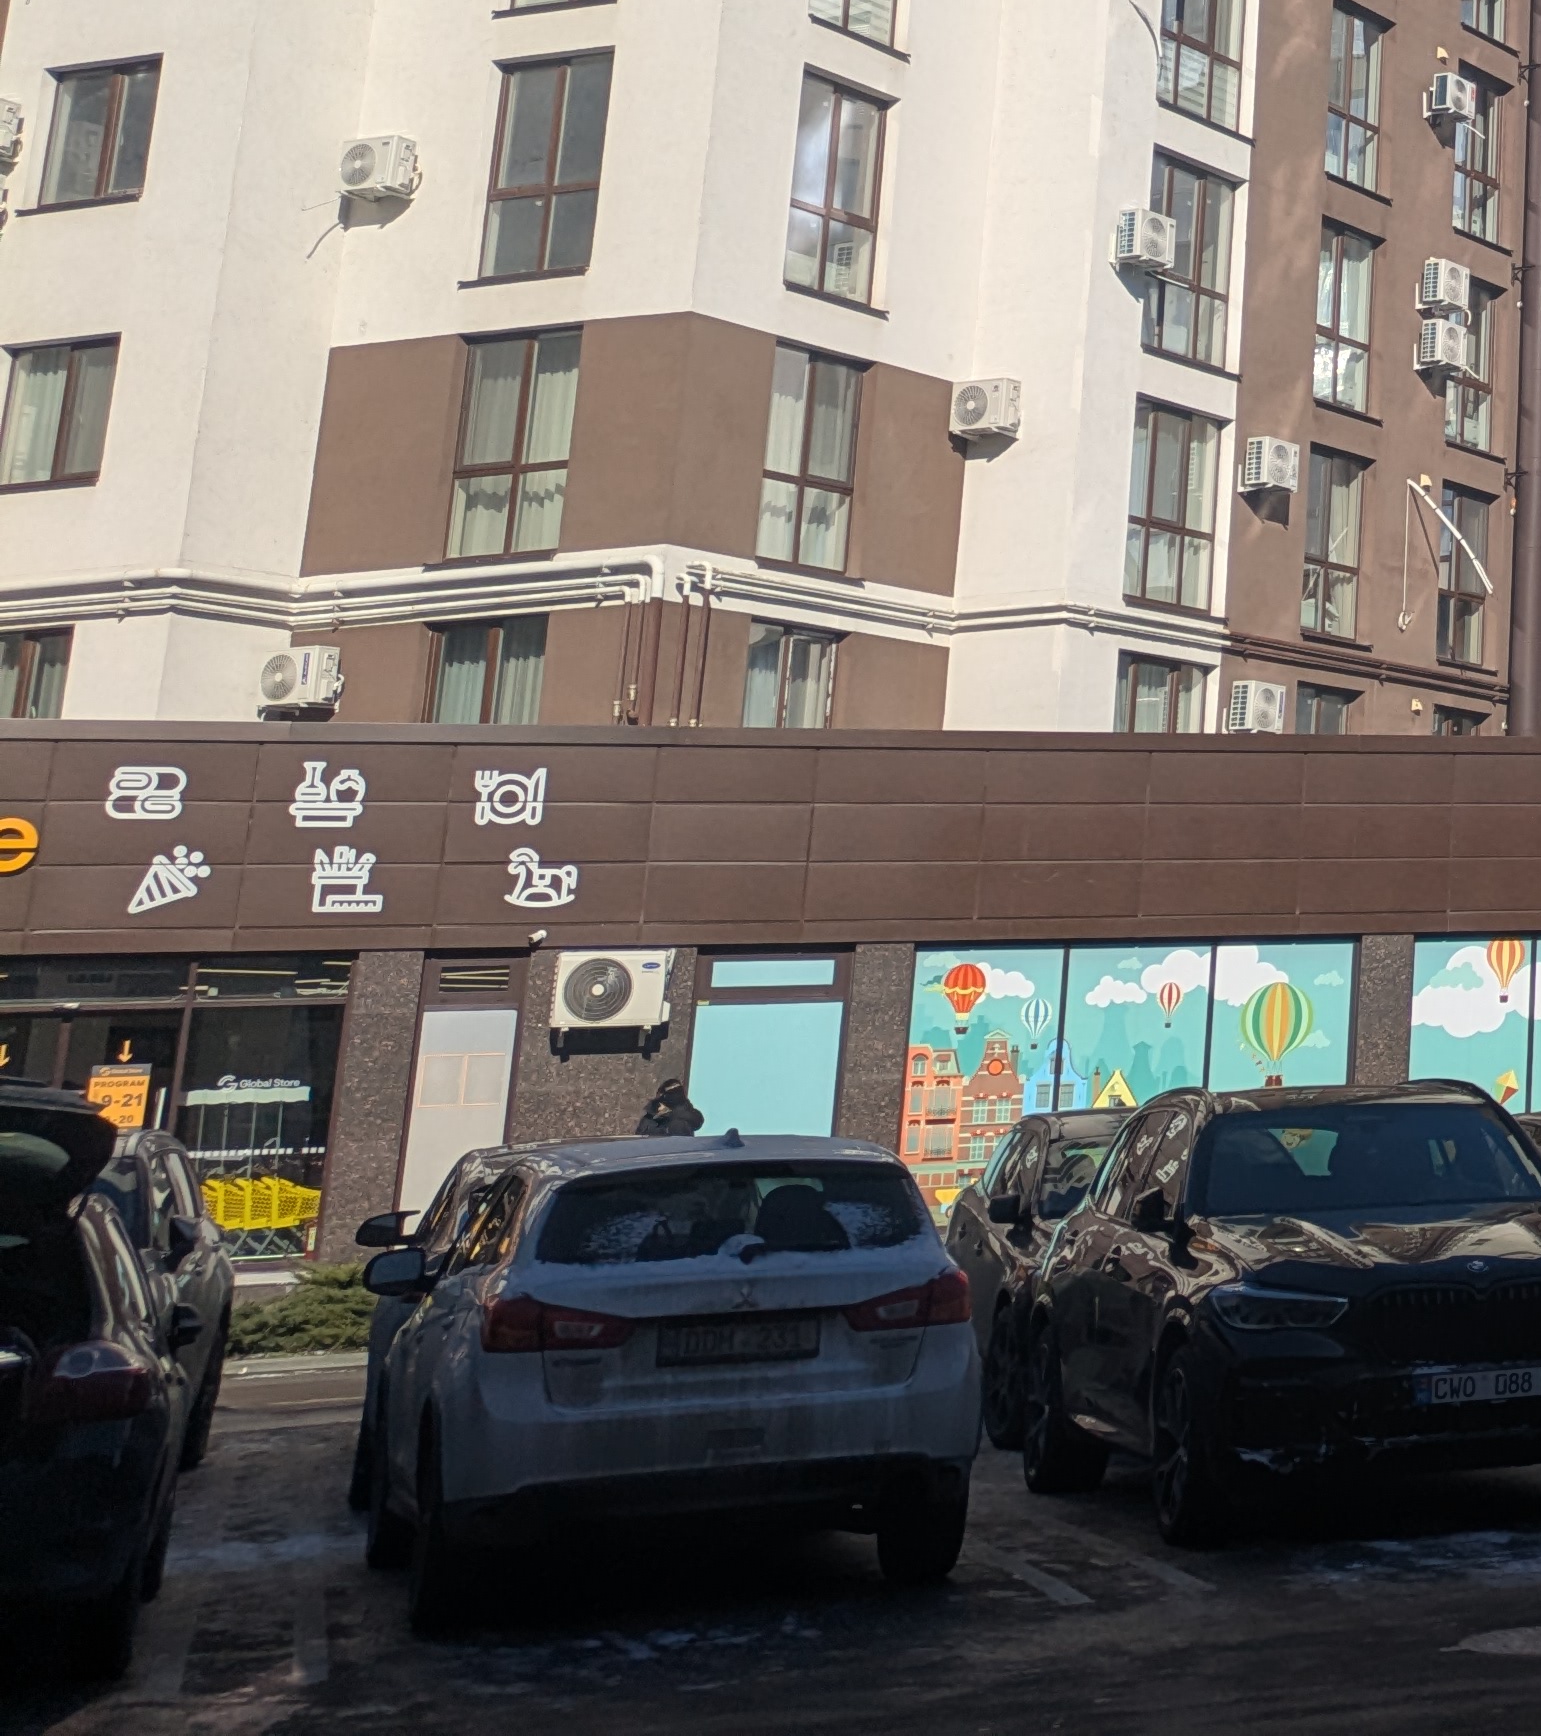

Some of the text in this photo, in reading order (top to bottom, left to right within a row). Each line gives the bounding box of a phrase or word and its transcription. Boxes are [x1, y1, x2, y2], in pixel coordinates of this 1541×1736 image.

[93, 1079, 146, 1089] PROGRAM
[239, 1078, 301, 1089] Global Store
[1434, 1375, 1476, 1400] CWO
